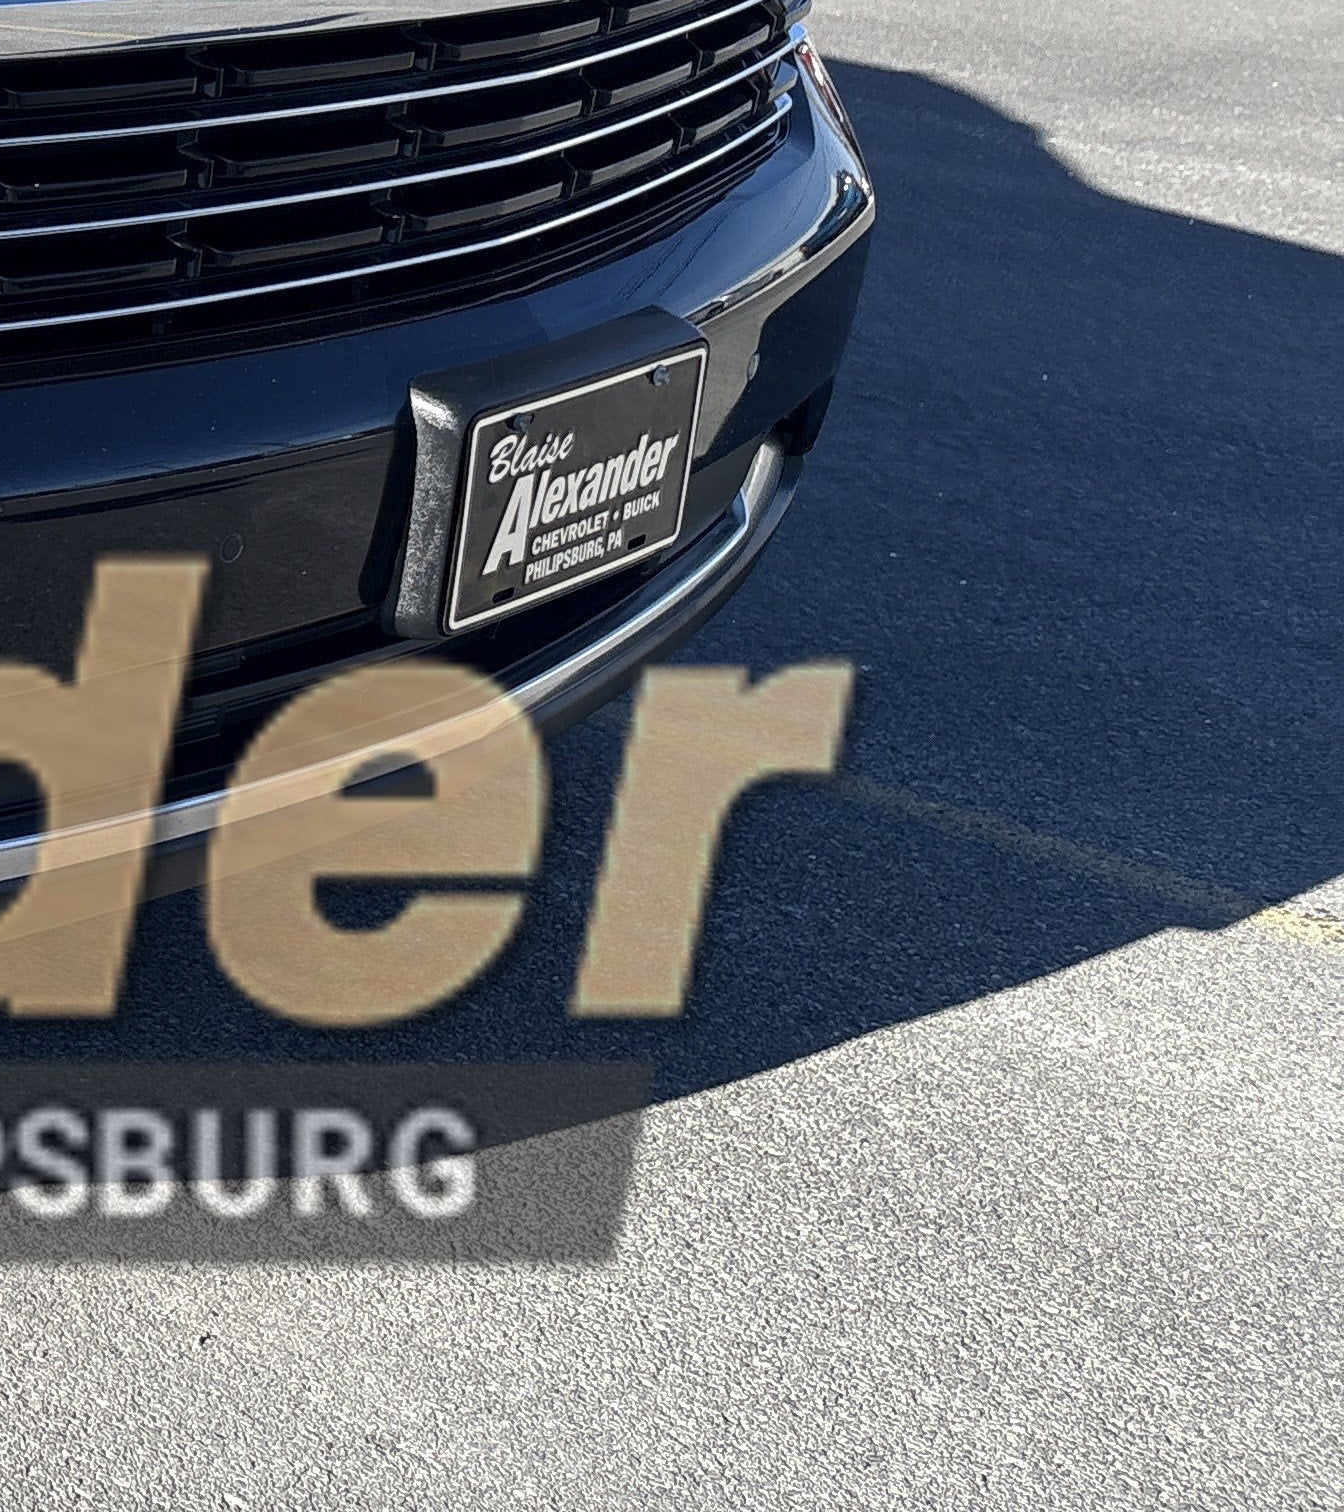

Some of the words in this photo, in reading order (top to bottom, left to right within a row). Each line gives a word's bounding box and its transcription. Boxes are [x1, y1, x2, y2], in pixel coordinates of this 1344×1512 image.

[488, 430, 575, 485] Blaise
[481, 433, 680, 577] Alexander
[531, 509, 610, 556] CHEVROLET
[622, 490, 661, 522] BUICK
[524, 543, 605, 585] PHILIPSBURG,
[606, 529, 624, 554] PA
